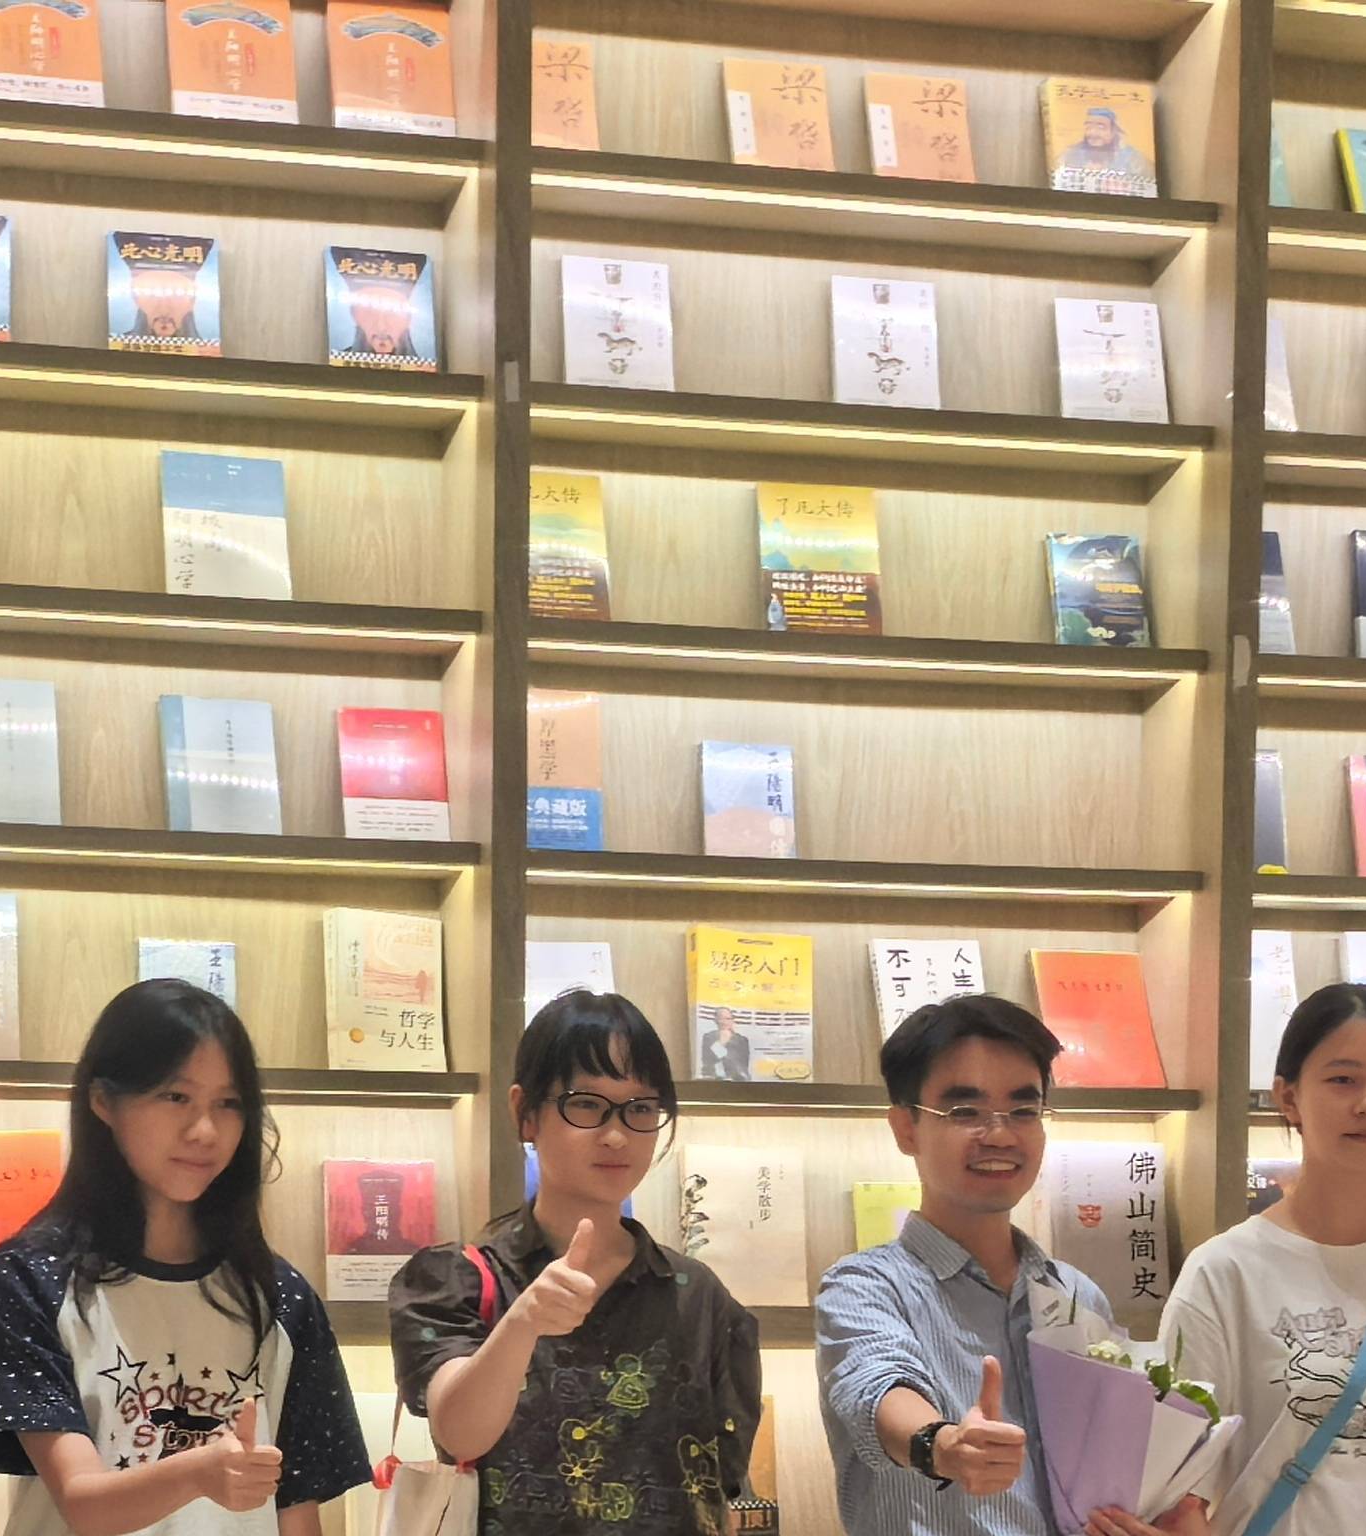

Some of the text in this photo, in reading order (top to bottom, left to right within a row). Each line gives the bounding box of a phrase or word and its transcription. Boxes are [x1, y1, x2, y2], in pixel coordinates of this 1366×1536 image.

[120, 242, 205, 264] 此心光明
[339, 258, 418, 281] 此心光明
[399, 1009, 435, 1030] 哲学
[379, 1031, 434, 1052] 与人生
[1125, 1151, 1163, 1300] 佛山简史
